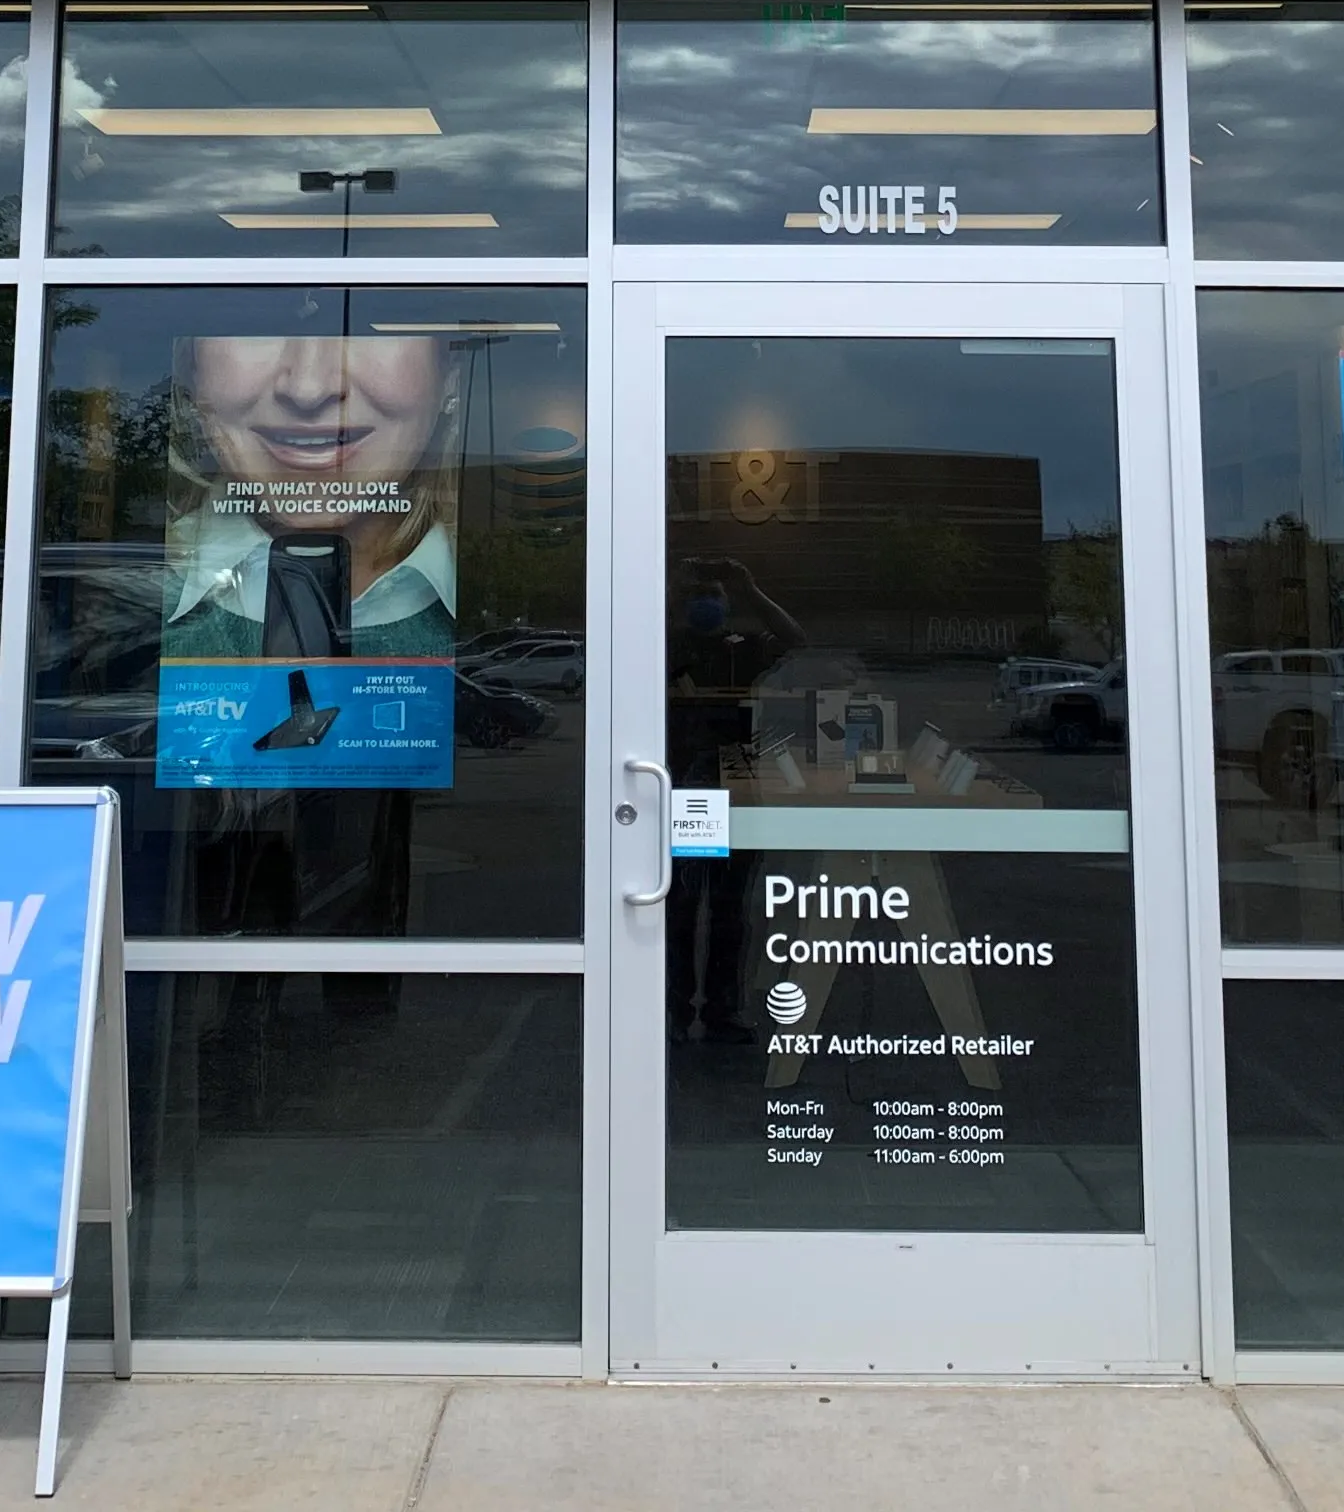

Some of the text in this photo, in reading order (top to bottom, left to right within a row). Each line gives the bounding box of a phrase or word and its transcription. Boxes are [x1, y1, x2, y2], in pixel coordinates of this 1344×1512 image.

[818, 184, 958, 235] SUITE 5
[227, 481, 399, 496] FIND WHAT YOU LOVE
[667, 450, 841, 525] T&T
[212, 499, 412, 513] WITH A VOICE COMMAND
[175, 682, 250, 692] INTRODUCING
[366, 676, 415, 684] TRY IT OUT
[396, 686, 428, 694] TODAY
[338, 739, 440, 748] SCAN TO LEARN MORE.
[765, 874, 910, 920] Prime
[765, 933, 1054, 966] Communications
[767, 1034, 1035, 1056] AT&T Authorized Retailer
[766, 1101, 824, 1116] Mon-Fri
[872, 1101, 935, 1116] 10:00am
[947, 1101, 1004, 1119] 8:00pm
[766, 1124, 834, 1143] Saturday
[872, 1125, 935, 1140] 10:00am
[947, 1125, 1004, 1143] 8:00pm
[766, 1148, 823, 1167] Sunday
[873, 1148, 936, 1164] 11:00am
[948, 1148, 1005, 1167] 6:00pm
